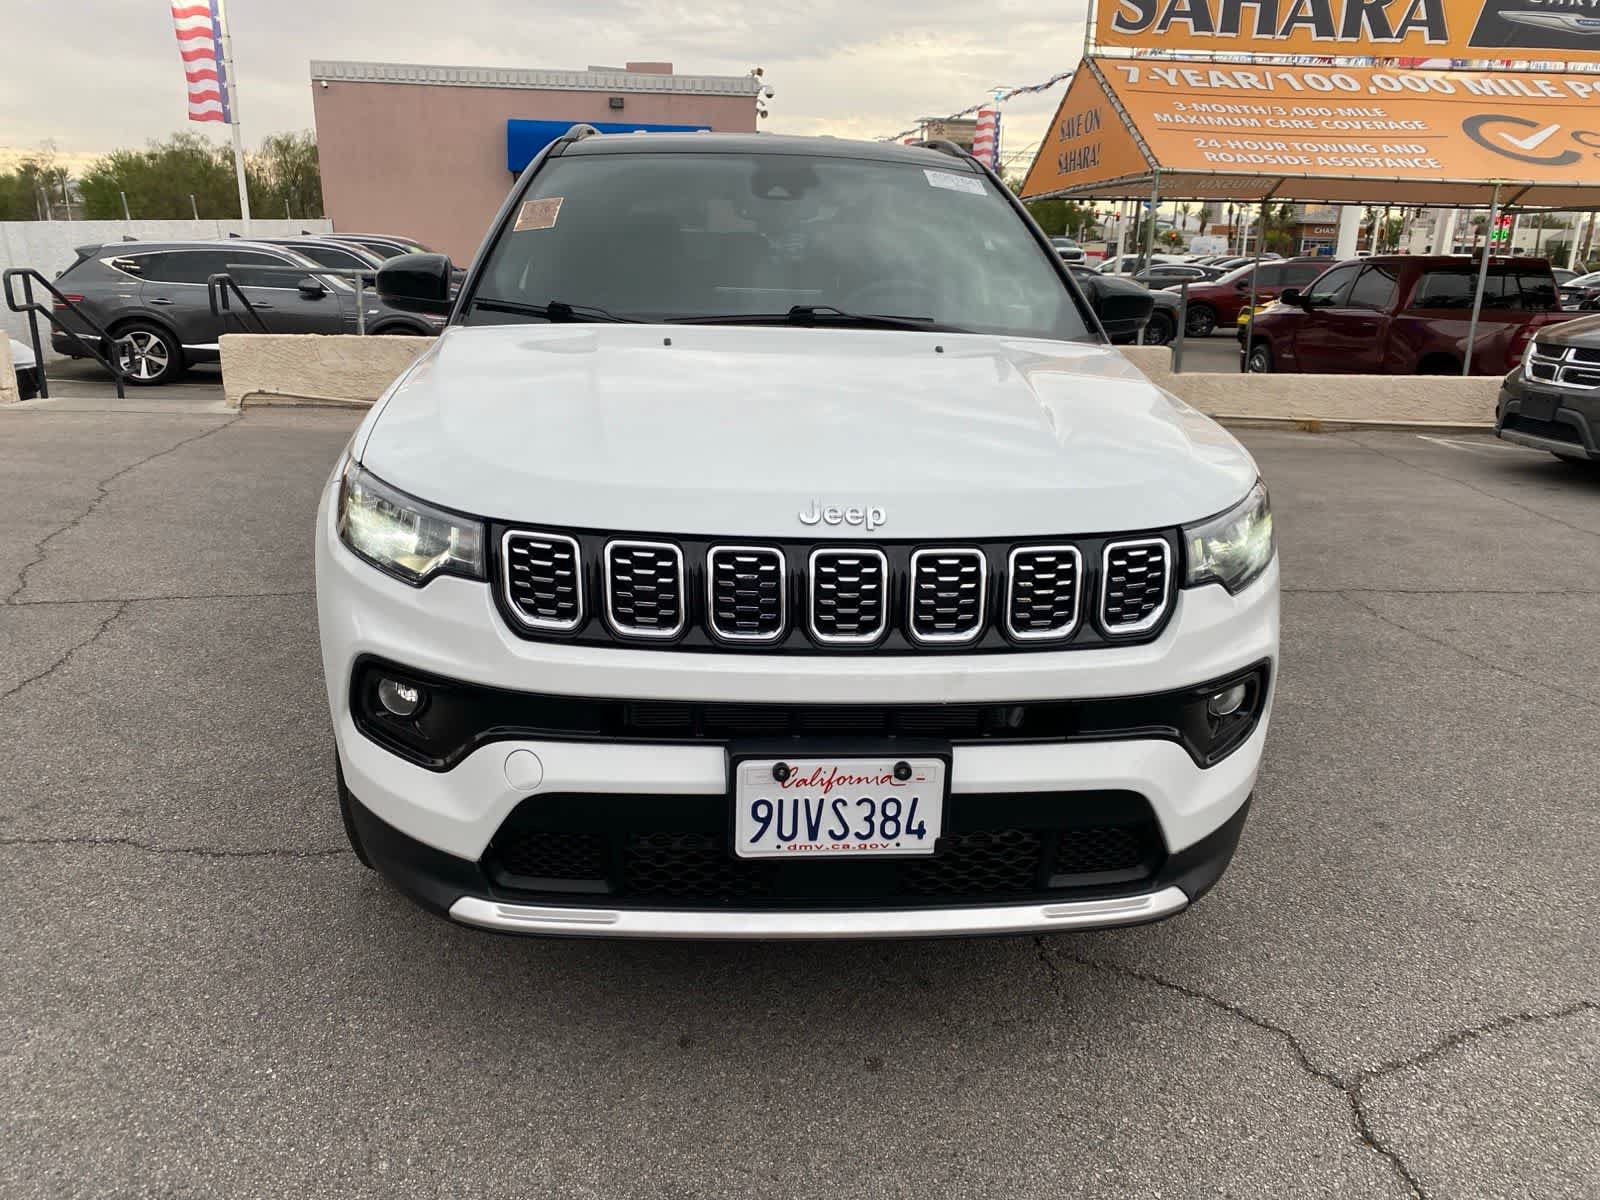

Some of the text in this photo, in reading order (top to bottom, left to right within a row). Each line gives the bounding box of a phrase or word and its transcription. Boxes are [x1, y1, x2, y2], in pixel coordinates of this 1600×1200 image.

[1459, 78, 1569, 98] MILE
[1173, 101, 1388, 119] 3-MONTH/3,000-MILE
[1060, 106, 1102, 142] SAVE ON
[1153, 112, 1429, 131] MAXIMUM CARE COVERAGE
[1193, 137, 1427, 155] 24-HOUR TOWING AND
[1057, 143, 1102, 175] SAHARA!
[1203, 151, 1442, 170] ROADSIDE ASSISTANCE
[798, 496, 887, 531] Jeep
[780, 765, 907, 795] California
[749, 796, 928, 844] 9UVS384
[786, 841, 890, 851] dmv.ca.gov
